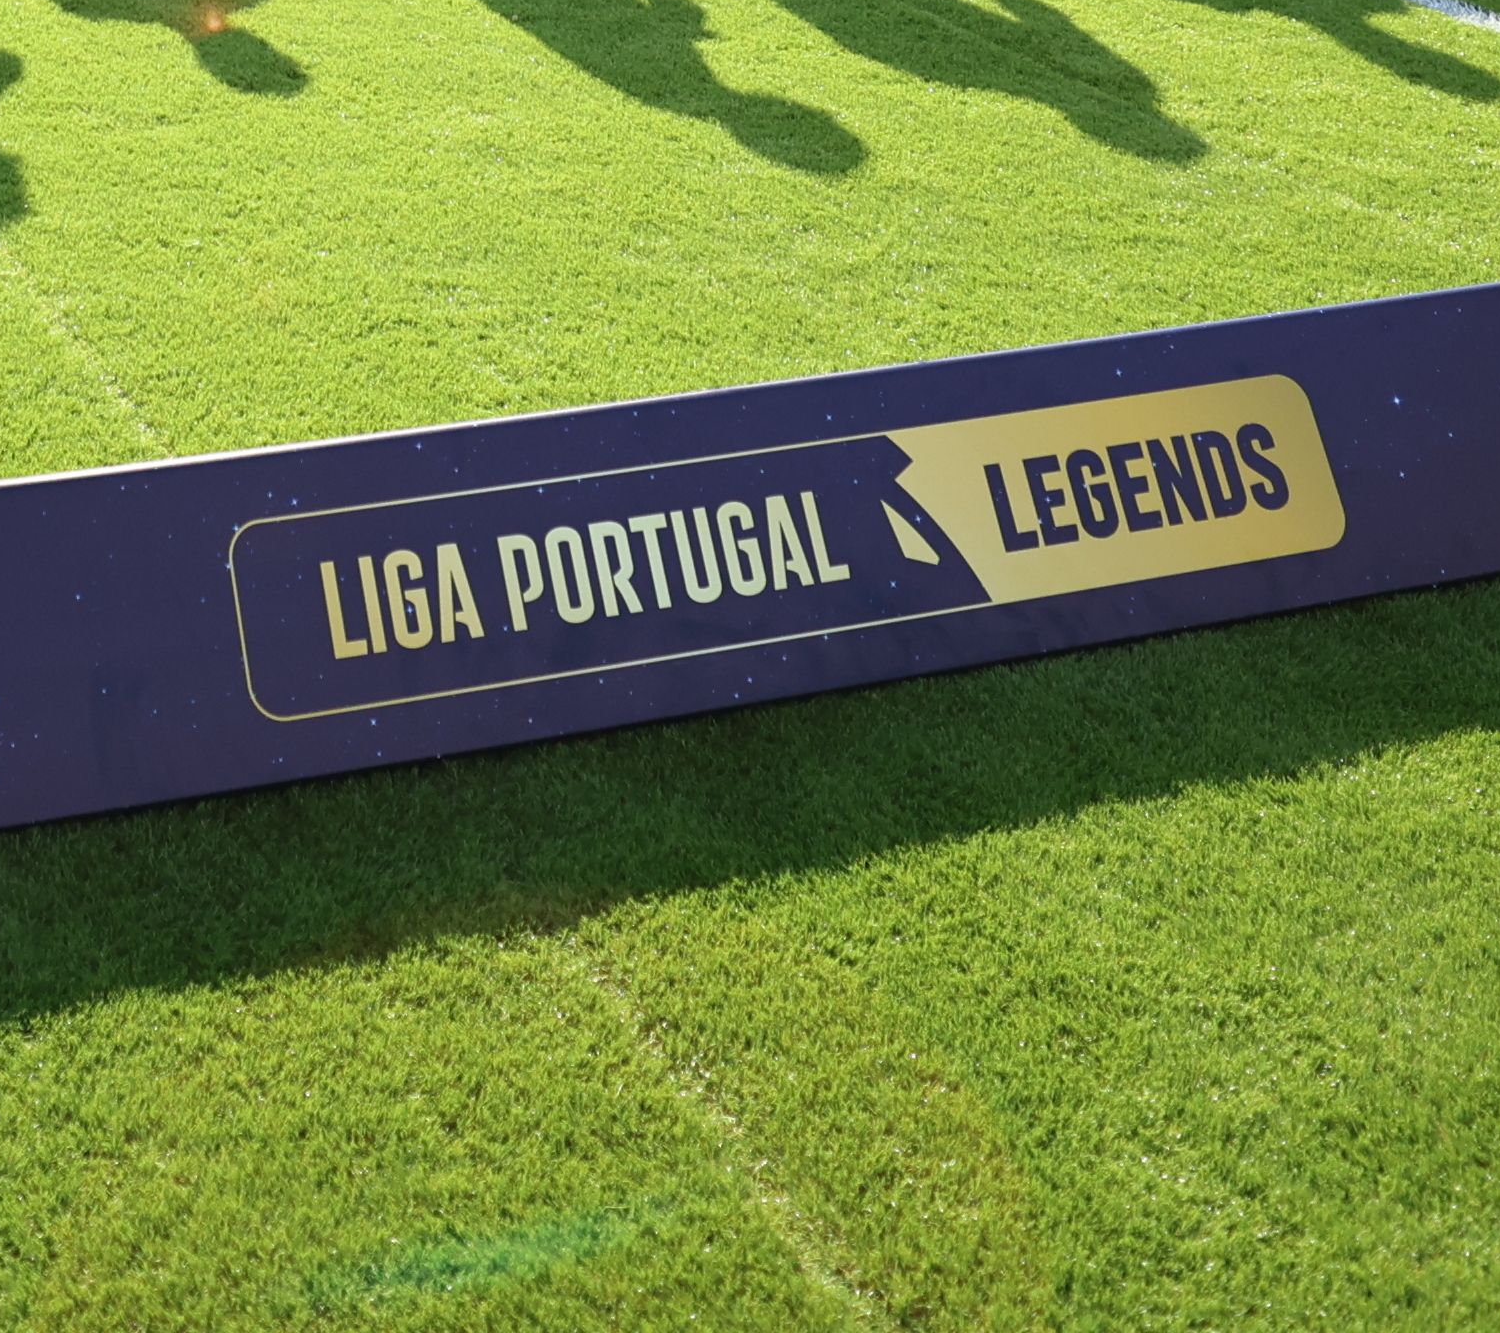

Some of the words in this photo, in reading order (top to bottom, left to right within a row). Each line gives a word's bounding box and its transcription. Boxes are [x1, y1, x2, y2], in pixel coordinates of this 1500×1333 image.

[320, 541, 485, 660] LIGA
[500, 489, 850, 633] PORTUGAL
[983, 421, 1291, 555] LEGENDS
